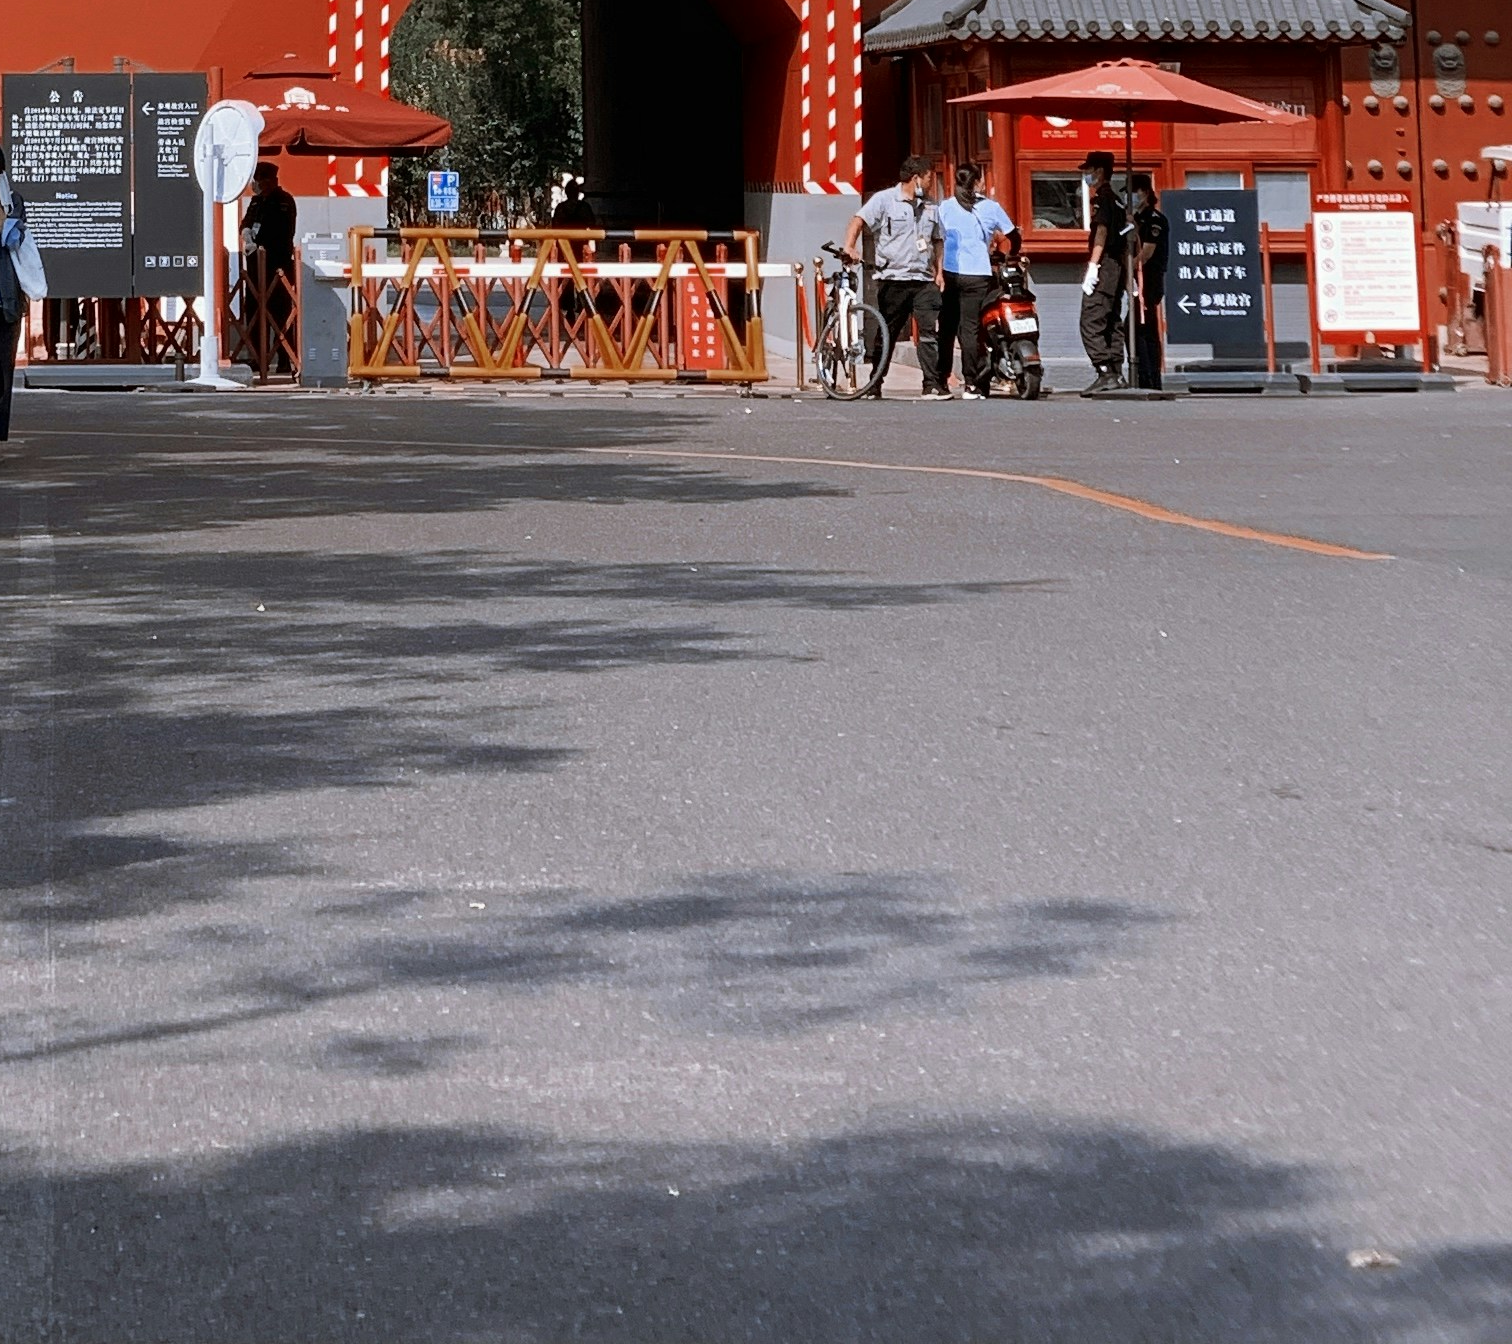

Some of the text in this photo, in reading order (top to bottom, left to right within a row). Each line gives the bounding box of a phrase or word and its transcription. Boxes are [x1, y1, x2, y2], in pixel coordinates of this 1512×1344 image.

[1184, 208, 1236, 222] 员工通道
[1177, 241, 1246, 255] 请出示证件
[1200, 293, 1252, 307] 参观故宫
